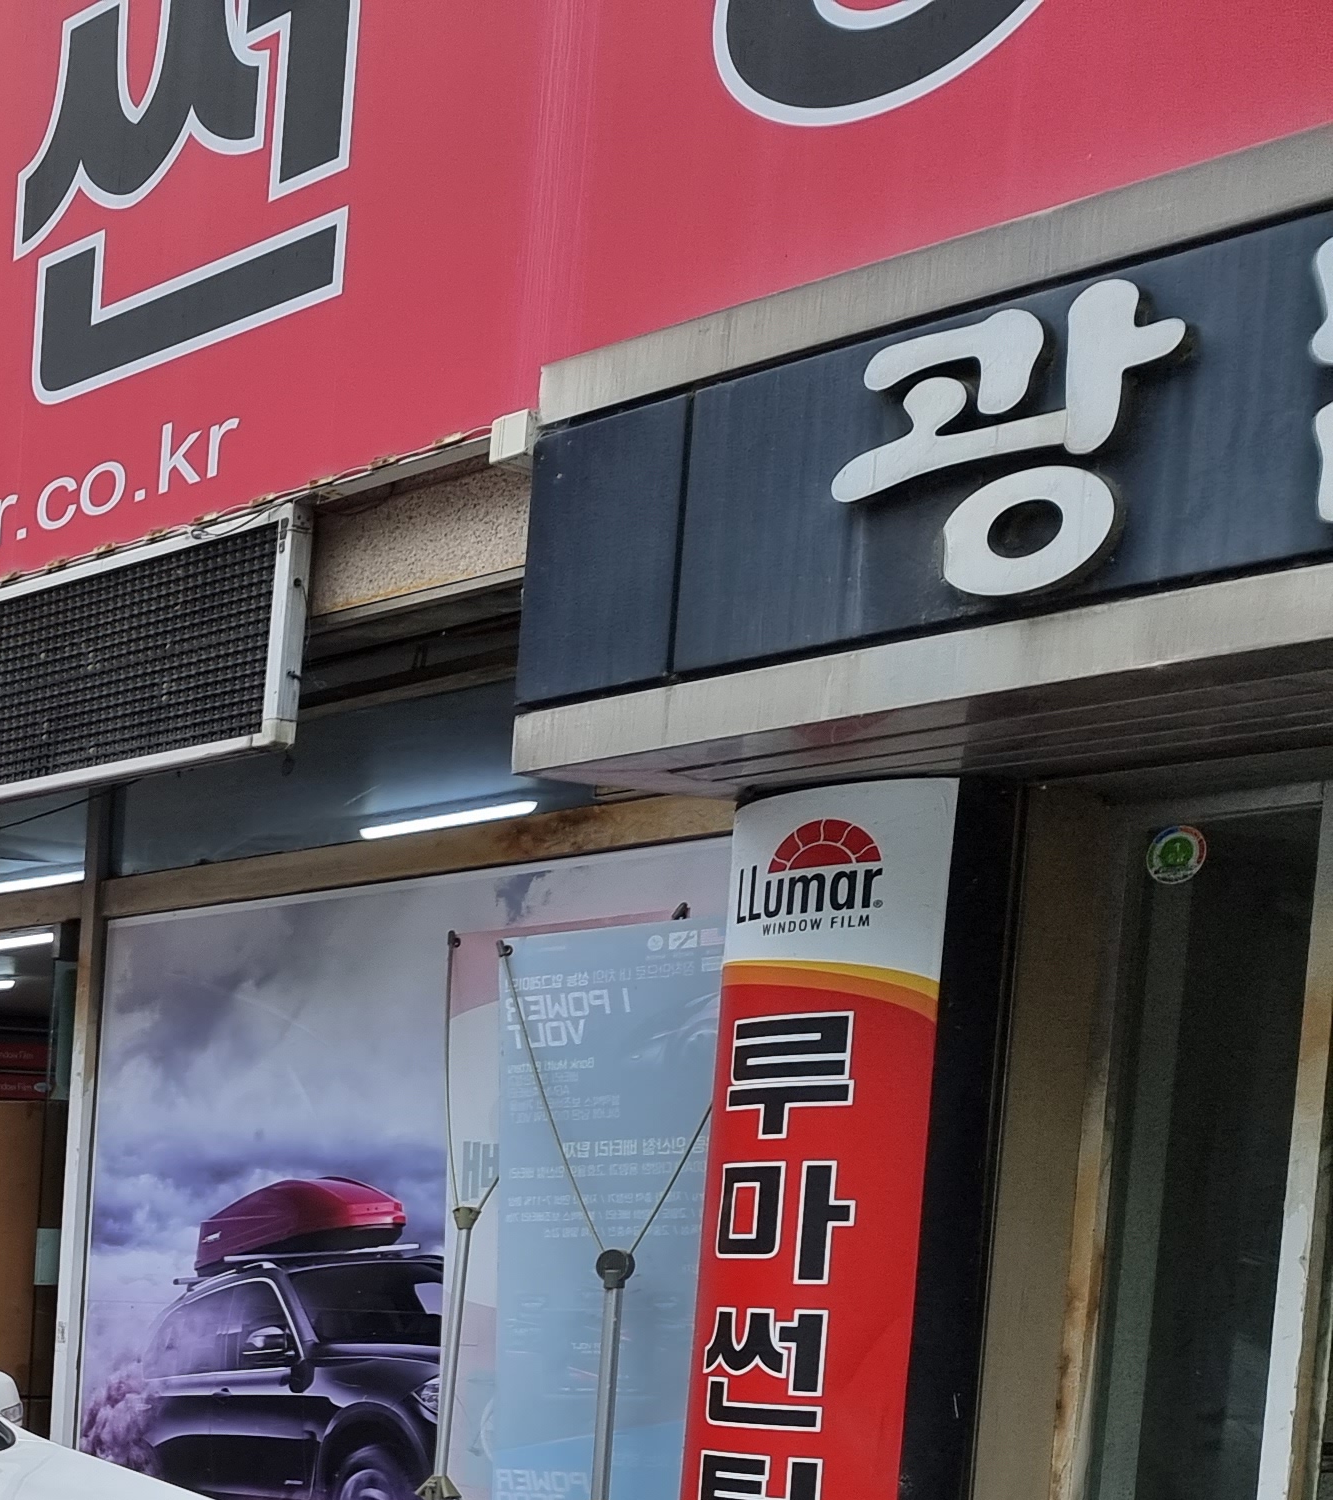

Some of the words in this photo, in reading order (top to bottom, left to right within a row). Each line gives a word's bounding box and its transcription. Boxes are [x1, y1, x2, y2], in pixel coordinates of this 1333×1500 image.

[830, 240, 1333, 597] 광
[736, 864, 883, 925] LLumar
[762, 917, 823, 936] WINDOW
[830, 912, 871, 931] FILM
